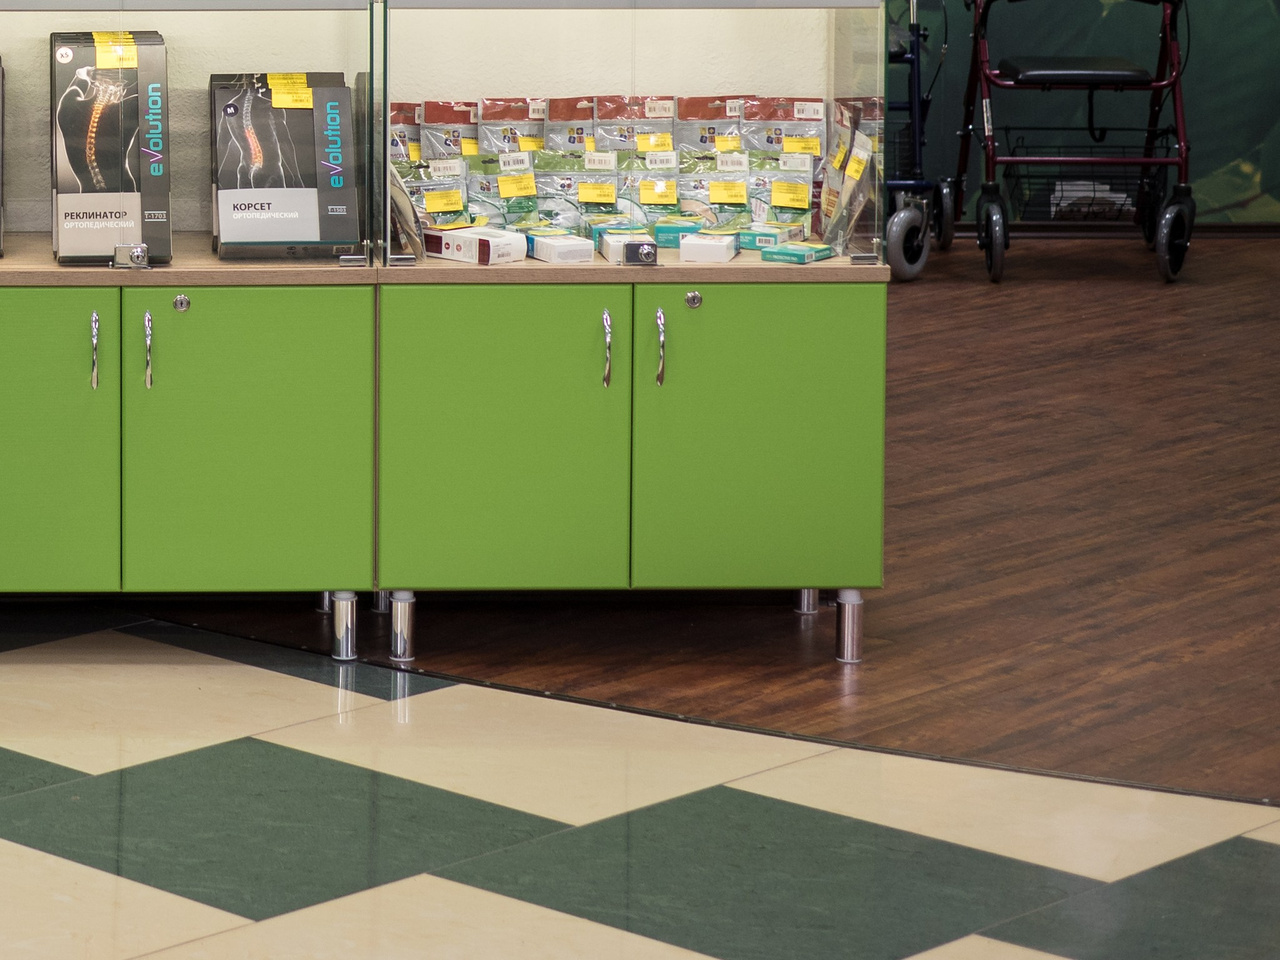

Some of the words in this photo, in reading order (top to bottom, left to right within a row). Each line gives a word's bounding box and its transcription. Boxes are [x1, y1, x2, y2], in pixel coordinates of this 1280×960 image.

[227, 106, 235, 114] M
[232, 202, 272, 211] КОРСЕТ
[64, 211, 127, 220] РЕКЛИНАТОР
[232, 211, 299, 220] ОРТОПЕДИЧЕСКИЙ
[64, 220, 135, 229] ОРТОПЕДИЧЕСКИЙ
